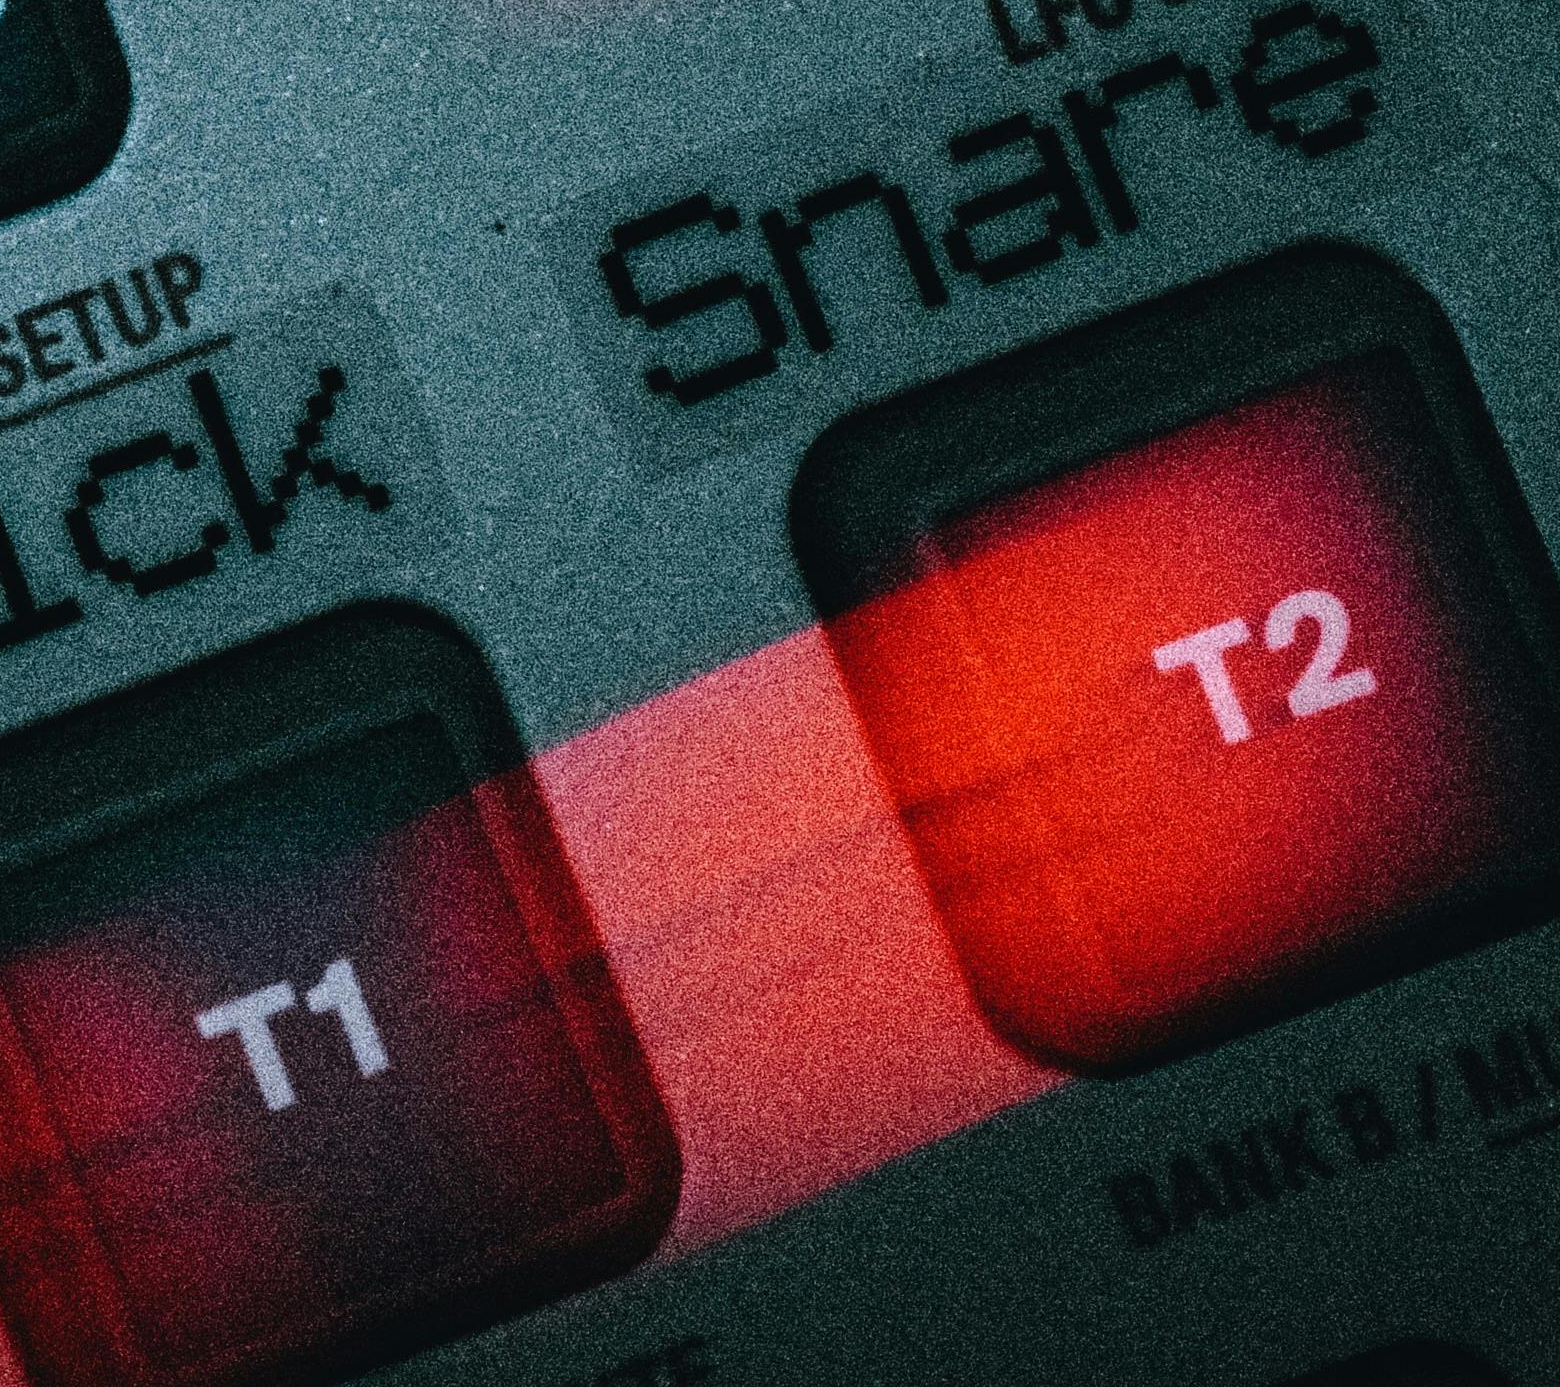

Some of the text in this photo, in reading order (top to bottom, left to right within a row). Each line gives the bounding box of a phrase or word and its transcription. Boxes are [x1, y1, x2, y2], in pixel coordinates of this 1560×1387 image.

[1153, 588, 1378, 747] T2
[194, 958, 391, 1113] T1
[1107, 1105, 1337, 1249] BANK
[1333, 1084, 1398, 1164] B
